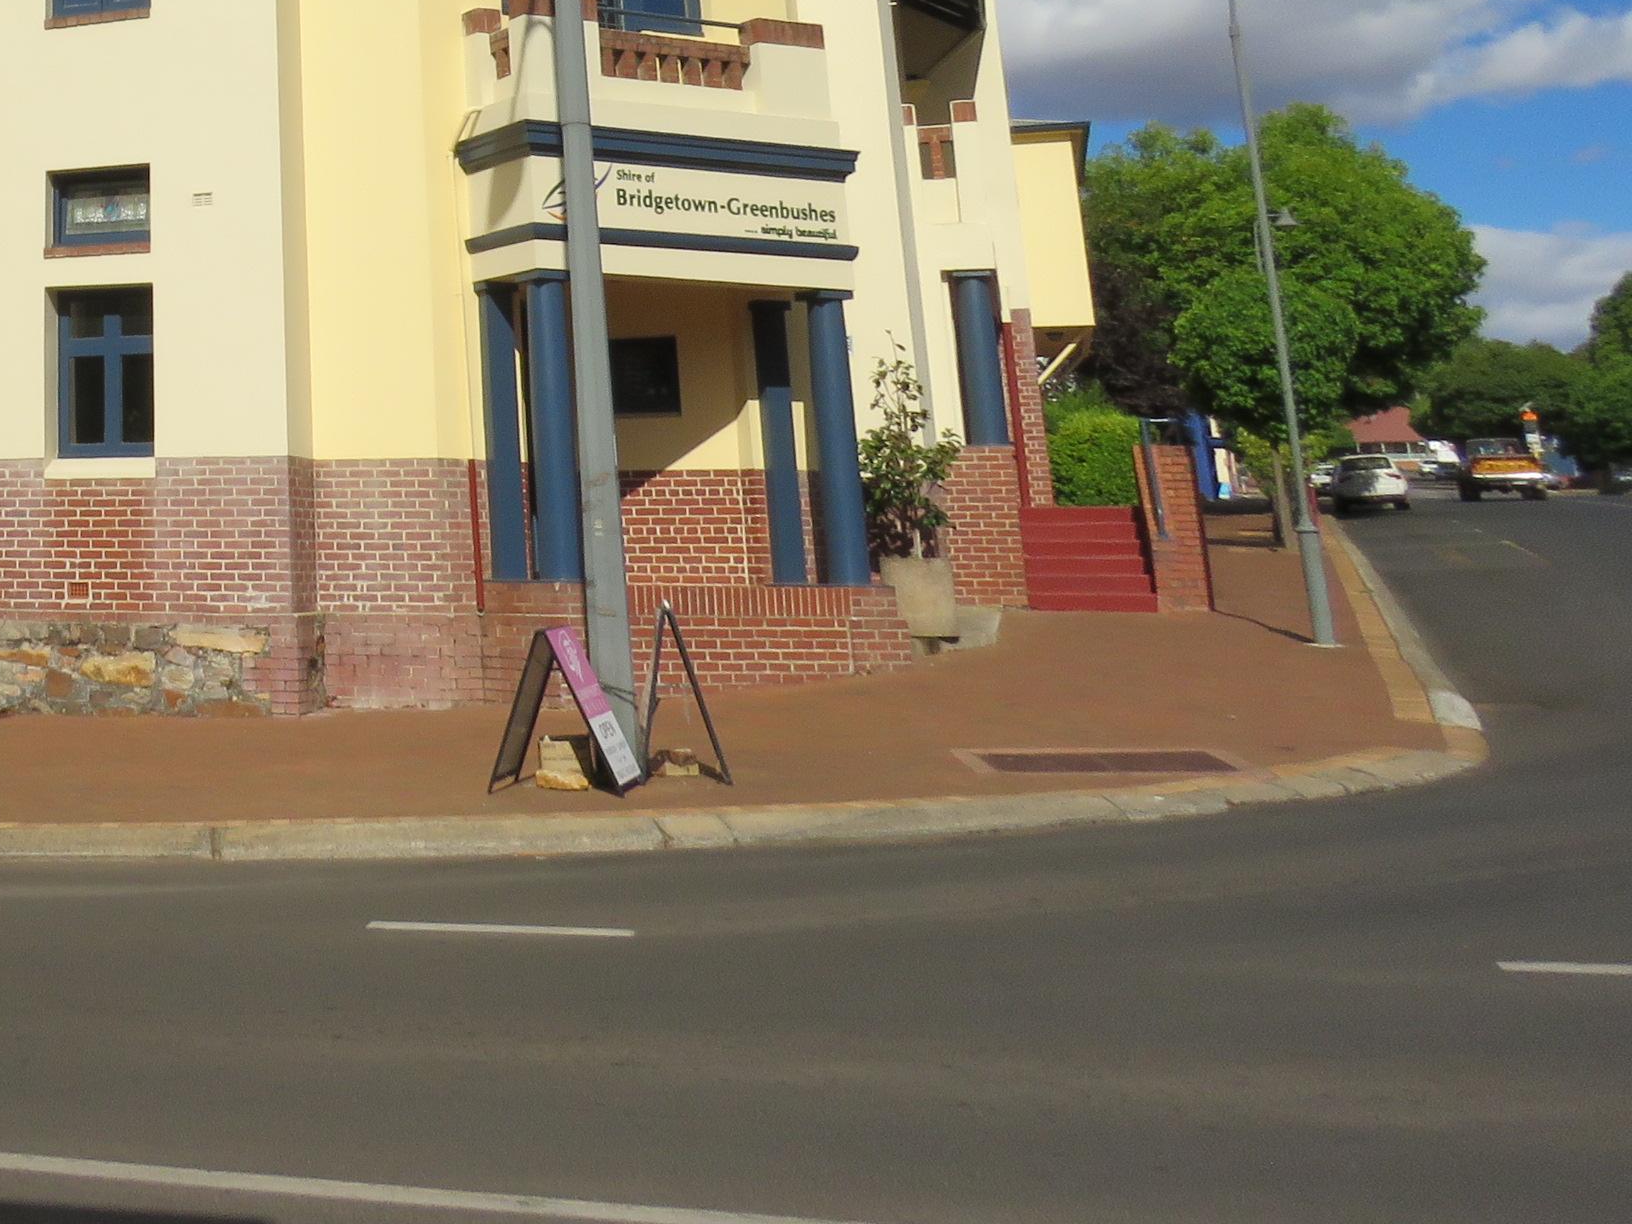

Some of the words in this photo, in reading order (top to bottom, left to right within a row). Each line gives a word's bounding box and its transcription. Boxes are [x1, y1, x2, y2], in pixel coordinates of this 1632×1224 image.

[616, 169, 642, 182] Shire
[645, 172, 655, 183] of
[616, 188, 836, 222] Bridgetown-Greenbushes
